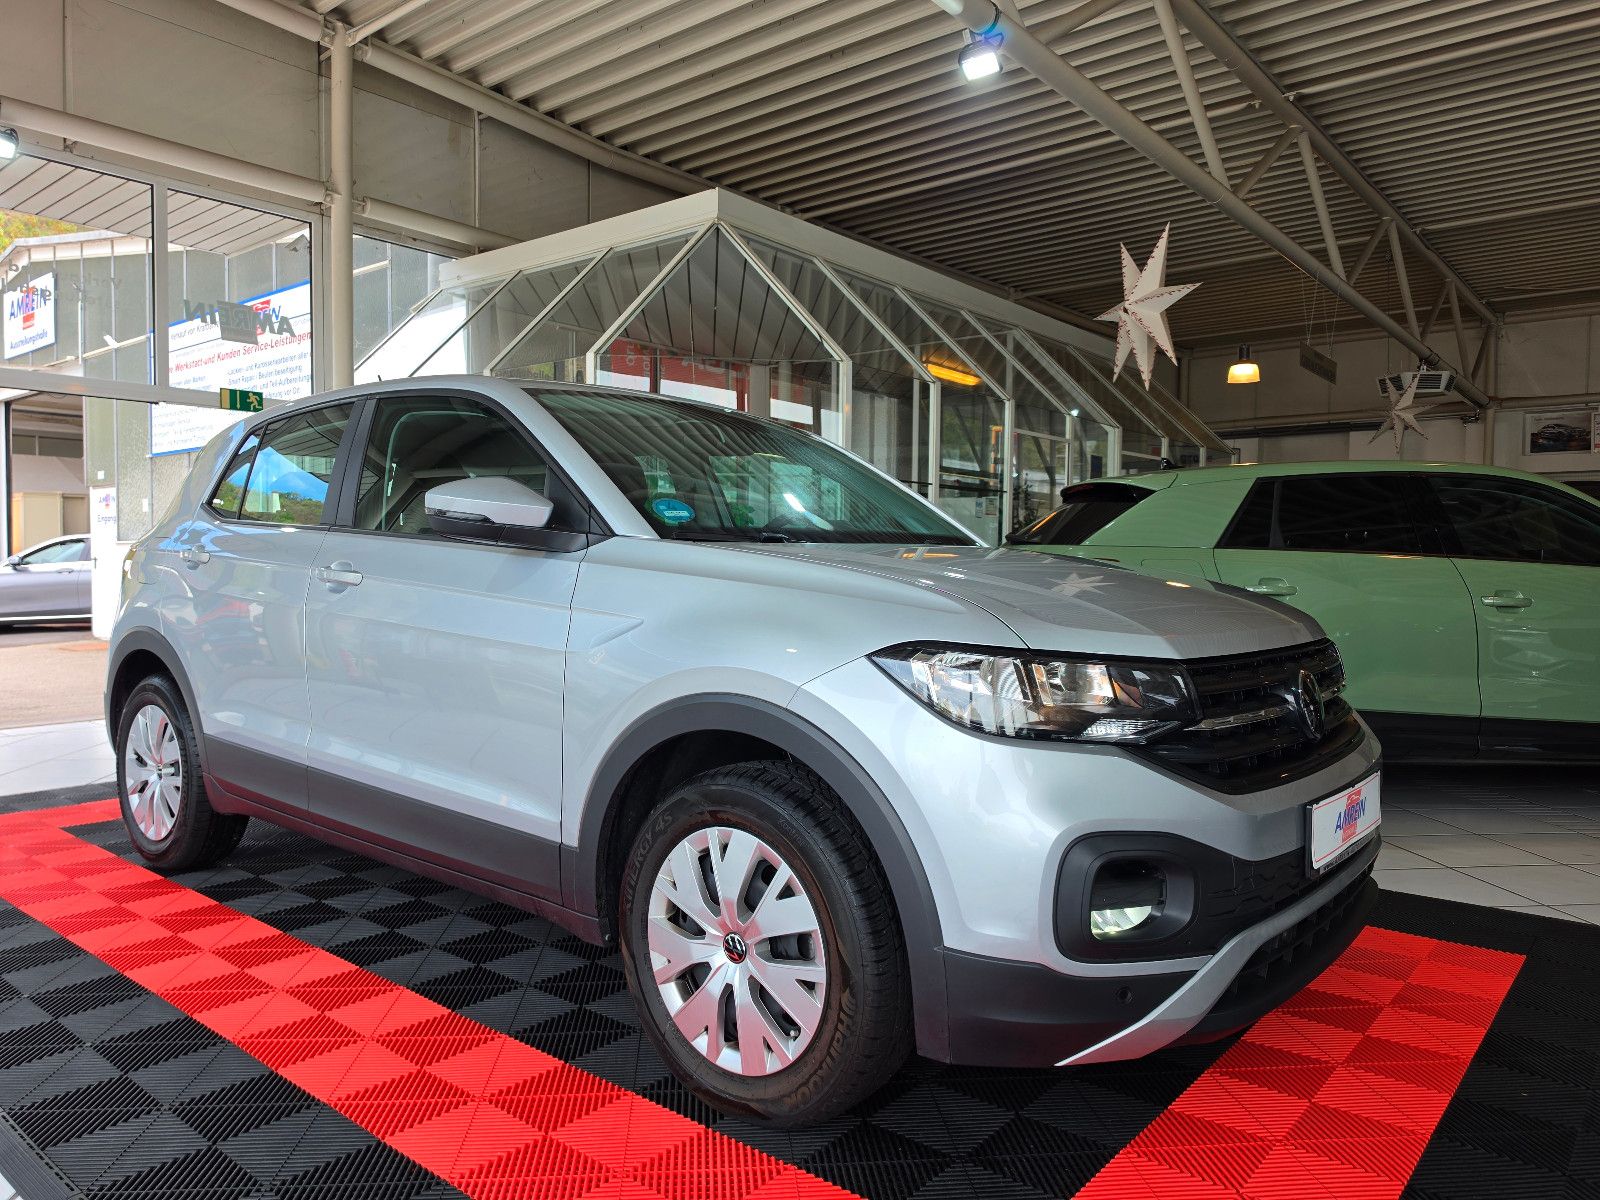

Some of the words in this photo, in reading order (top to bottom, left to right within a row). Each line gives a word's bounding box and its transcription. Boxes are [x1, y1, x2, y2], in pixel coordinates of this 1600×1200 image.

[9, 287, 47, 320] AMREIN
[216, 348, 241, 363] Kunden
[1334, 796, 1367, 833] AMREIN
